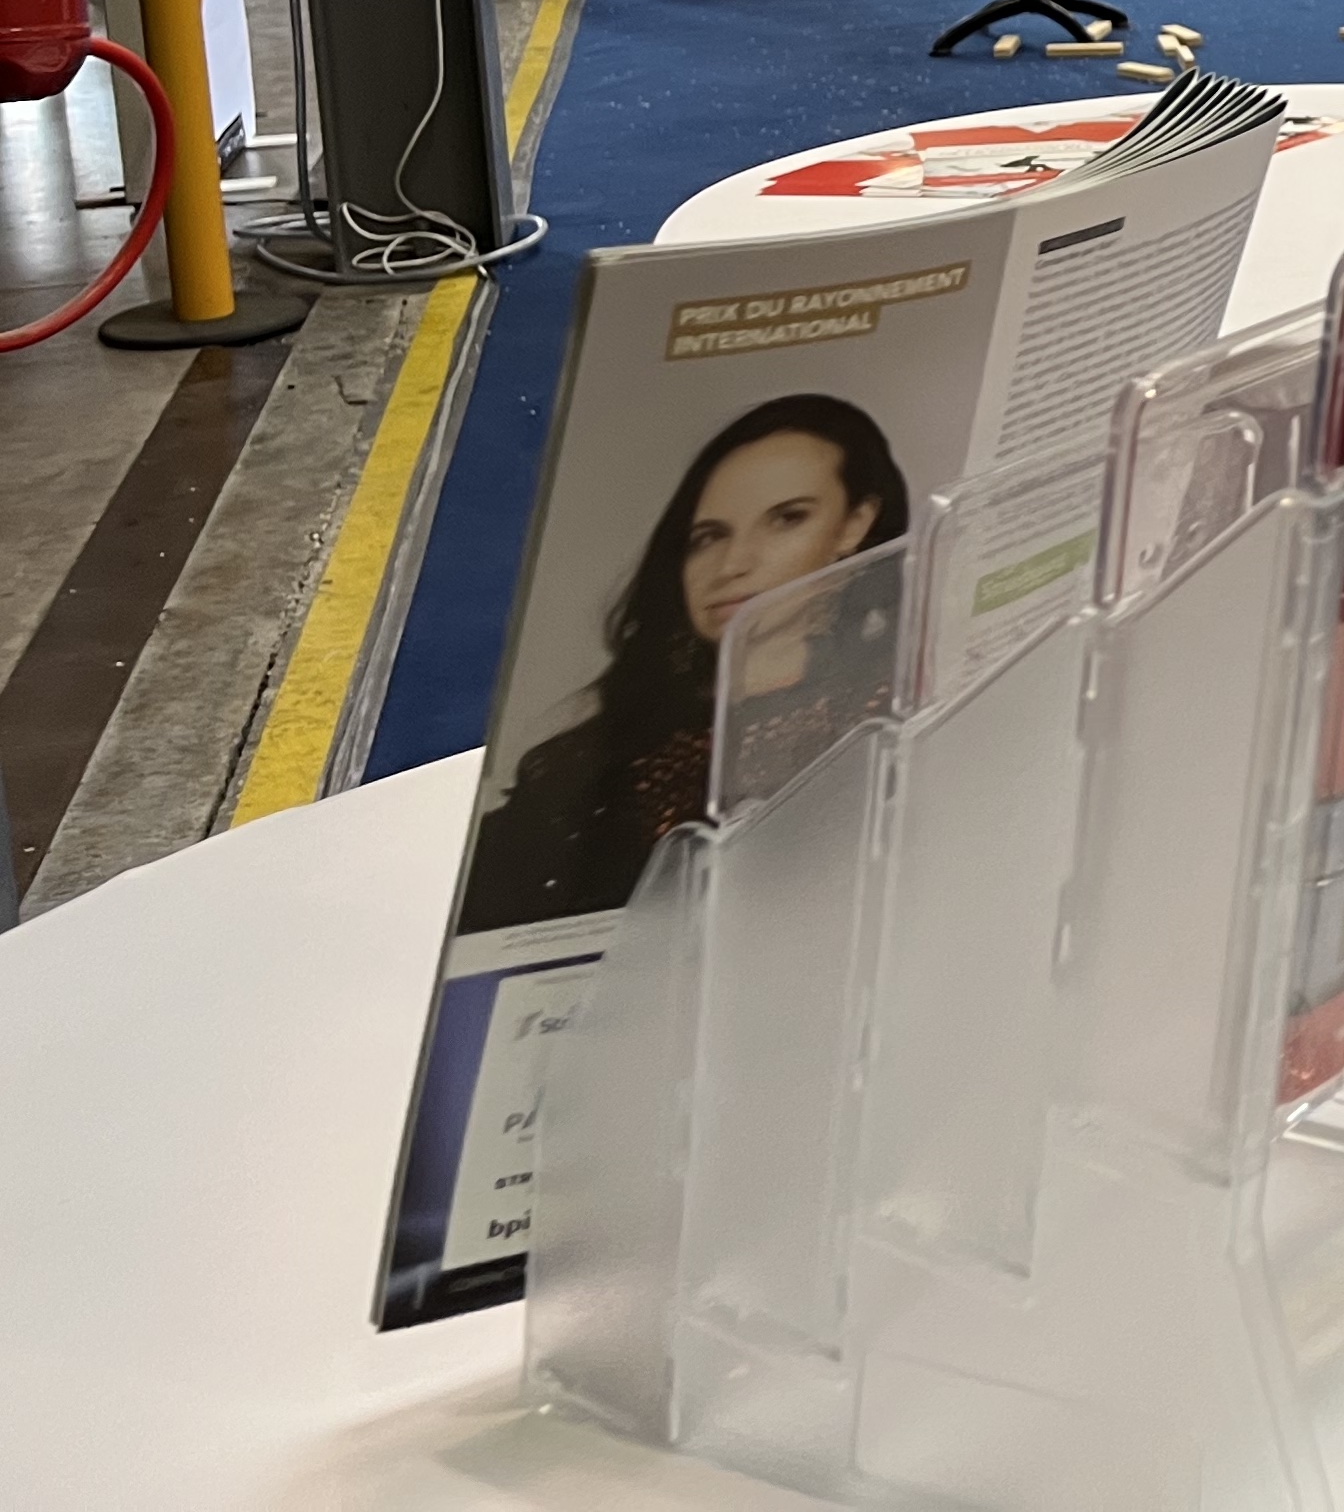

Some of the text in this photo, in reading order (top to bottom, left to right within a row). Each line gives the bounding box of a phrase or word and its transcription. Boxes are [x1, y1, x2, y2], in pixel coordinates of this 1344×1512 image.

[679, 267, 967, 326] PRIX DU RAYONNEMENT
[672, 311, 874, 357] INTERNATIONAL
